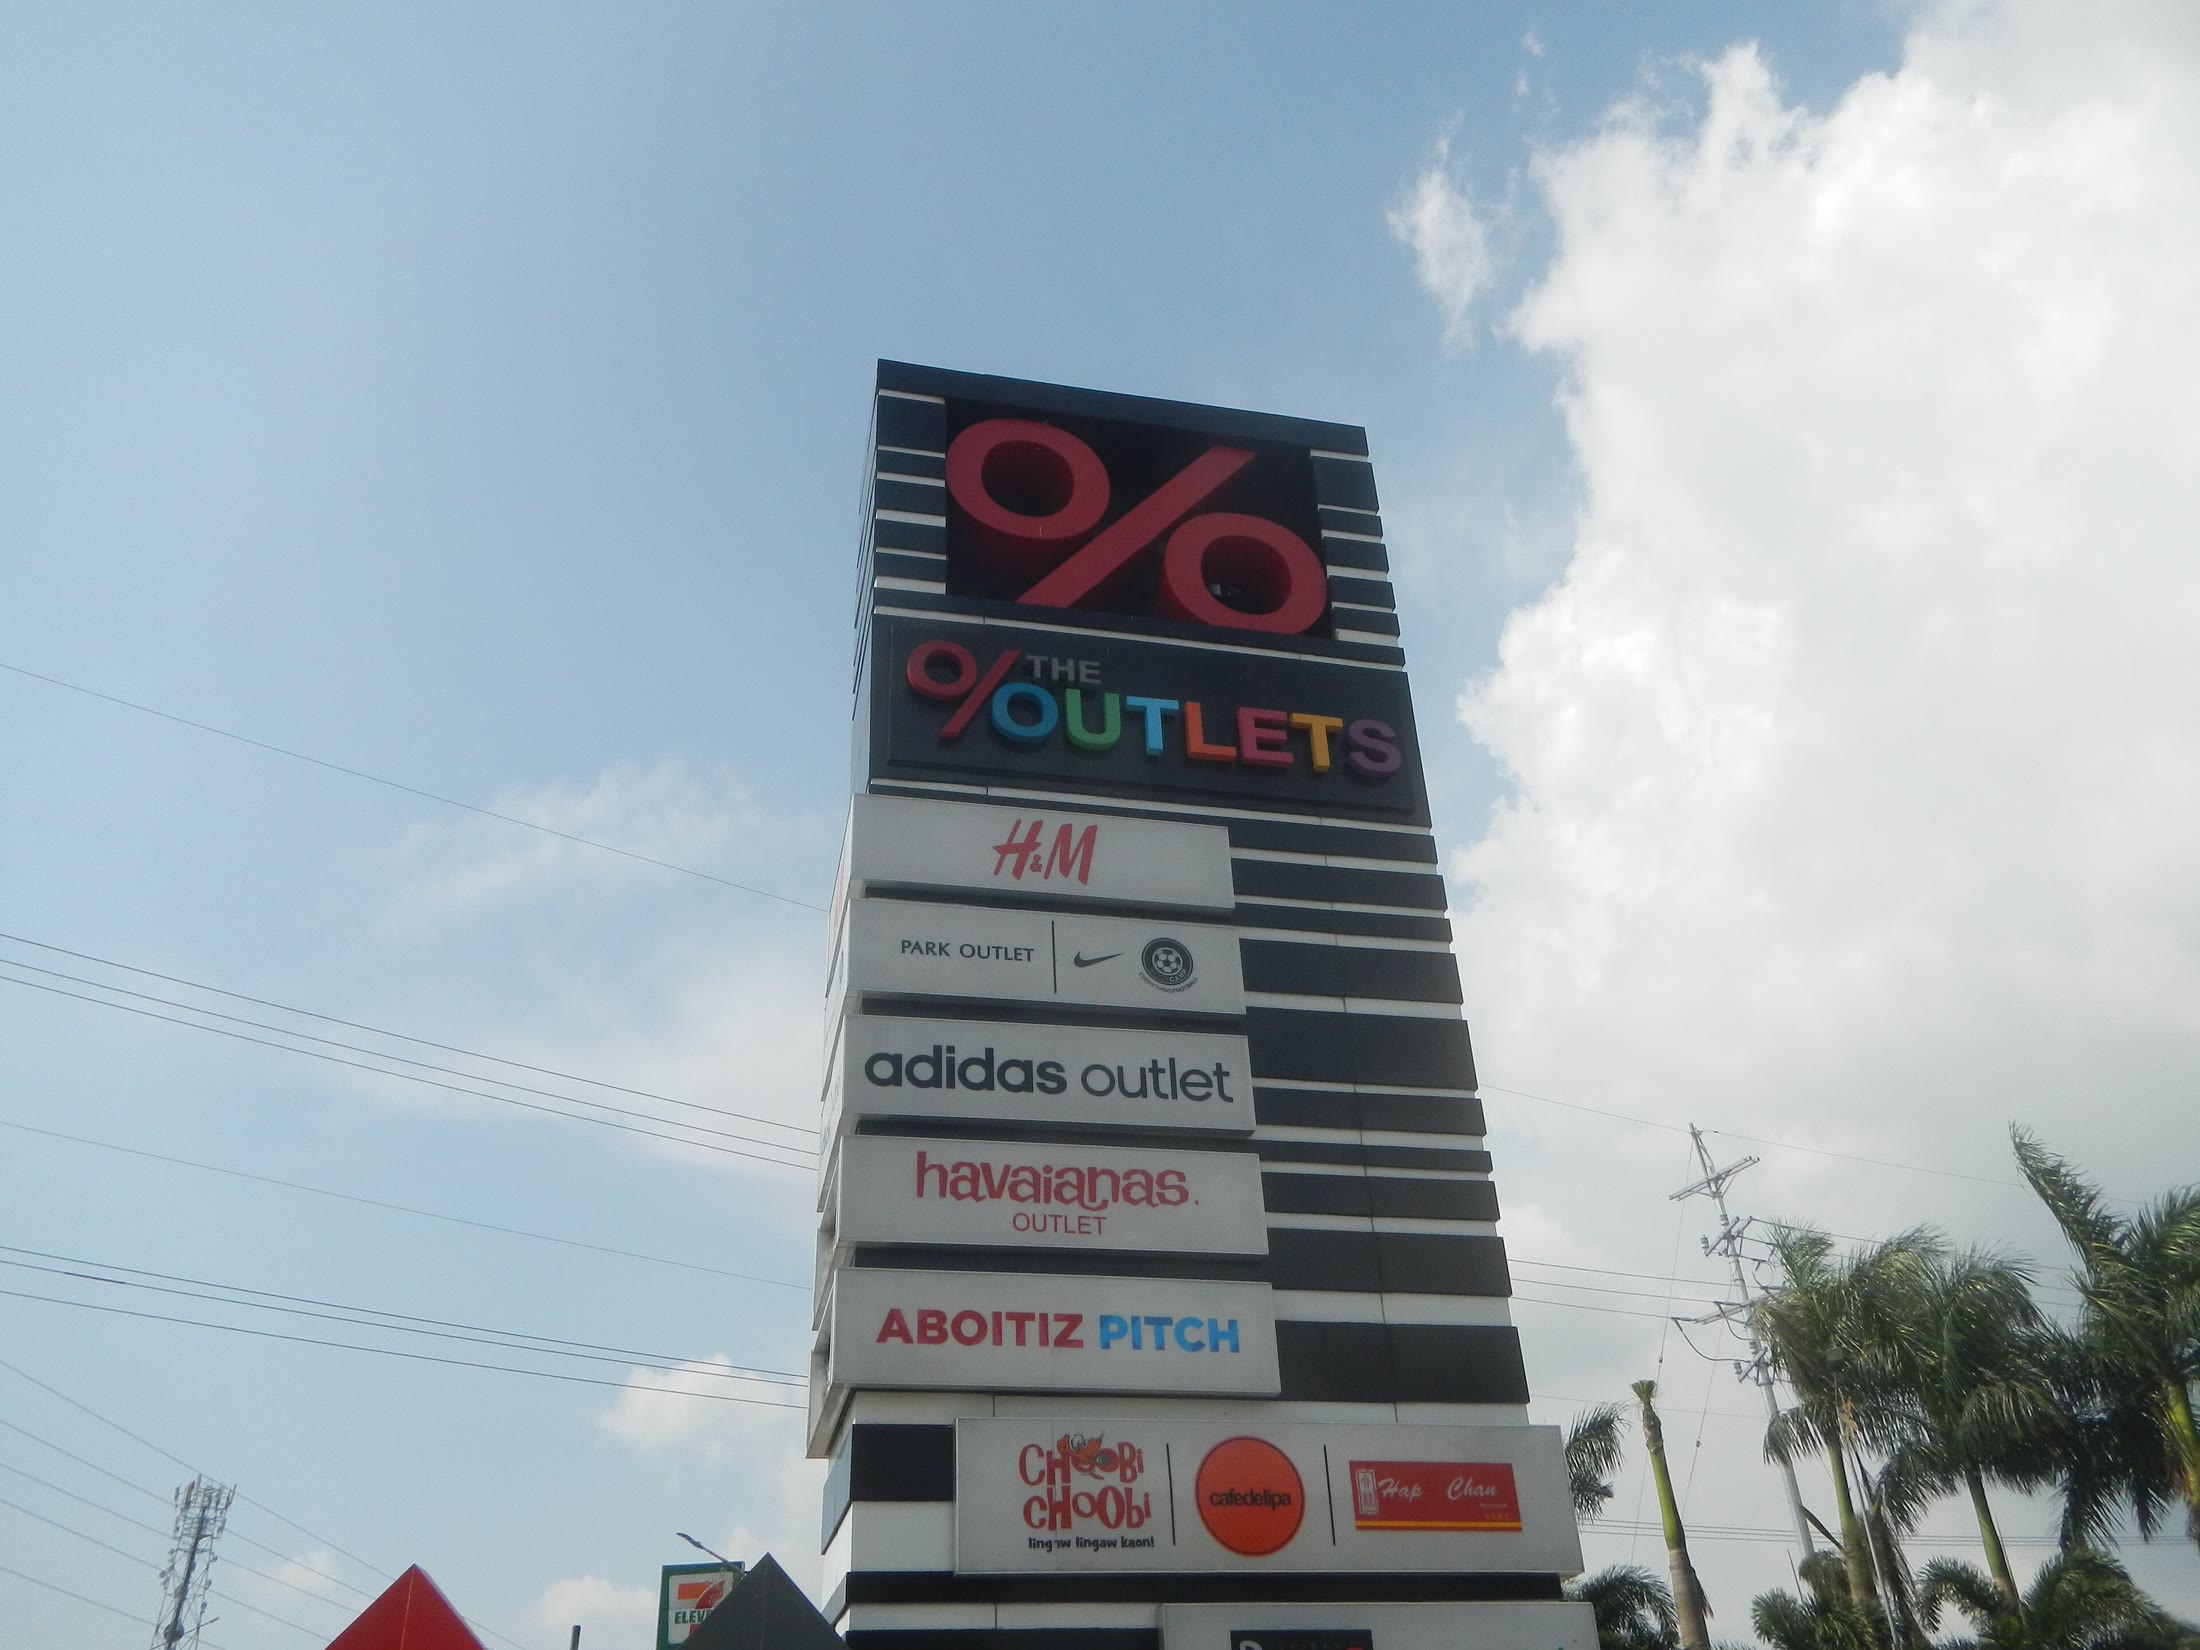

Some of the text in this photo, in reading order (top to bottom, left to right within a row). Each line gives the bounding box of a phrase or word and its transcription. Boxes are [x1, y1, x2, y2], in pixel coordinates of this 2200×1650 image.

[1026, 655, 1102, 685] THE
[991, 681, 1401, 780] OUTLETS
[993, 818, 1098, 886] H&M
[901, 939, 1034, 963] PARK OUTLET
[864, 1045, 1234, 1103] adidas outlet
[1012, 1212, 1106, 1235] OUTLET
[875, 1308, 1240, 1353] ABOITIZ PITCH
[1209, 1488, 1291, 1510] cafedelipa
[1378, 1477, 1497, 1502] Hap Chan
[1076, 1536, 1117, 1552] lingaw
[1121, 1536, 1155, 1549] kaon!
[674, 1610, 709, 1624] ELEV
